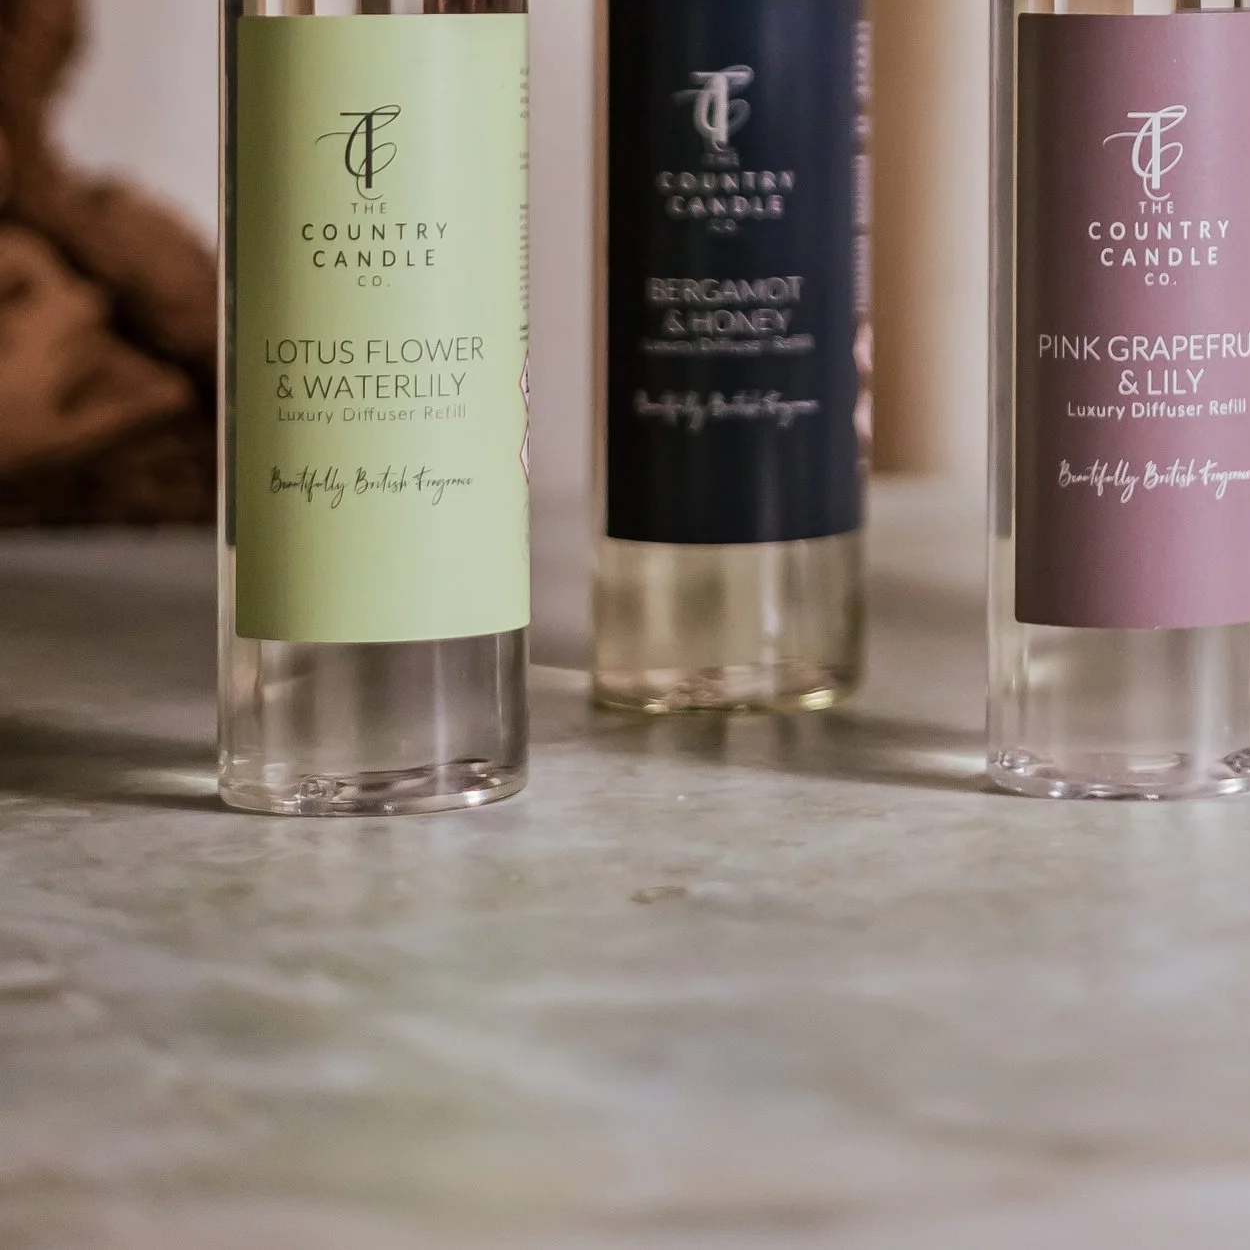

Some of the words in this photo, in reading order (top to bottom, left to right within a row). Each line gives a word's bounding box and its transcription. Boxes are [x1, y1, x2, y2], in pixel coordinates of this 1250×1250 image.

[351, 202, 388, 214] THE
[1139, 201, 1175, 215] THE
[301, 222, 448, 241] COUNTRY
[1088, 219, 1230, 241] COUNTRY
[312, 249, 436, 268] CANDLE
[1100, 246, 1219, 267] CANDLE
[357, 275, 391, 287] CO.
[646, 276, 803, 304] BERGAMOT
[1144, 272, 1177, 286] CO.
[691, 307, 791, 334] HONEY
[265, 339, 355, 365] LOTUS
[366, 336, 485, 363] FLOWER
[1038, 333, 1101, 361] PINK
[276, 374, 294, 399] &
[303, 372, 467, 399] WATERLILY
[1118, 369, 1139, 396] &
[1147, 368, 1204, 396] LILY
[278, 406, 334, 424] Luxury
[343, 406, 416, 422] Diffuser
[424, 403, 467, 419] Refill
[1067, 401, 1126, 420] Luxury
[1131, 400, 1203, 419] Diffuser
[1209, 398, 1247, 416] Refill
[353, 464, 409, 494] British
[1142, 458, 1197, 490] British
